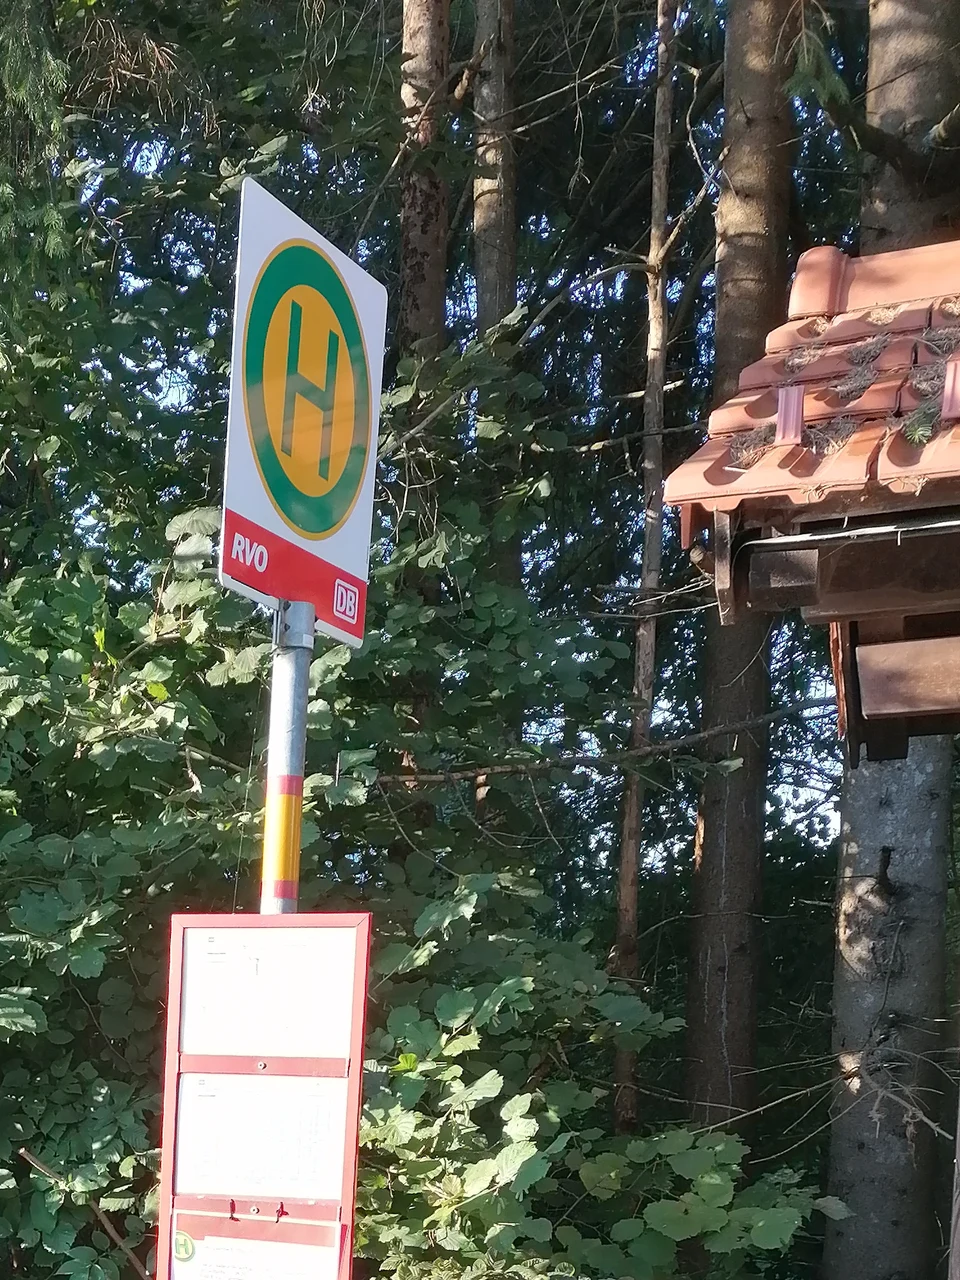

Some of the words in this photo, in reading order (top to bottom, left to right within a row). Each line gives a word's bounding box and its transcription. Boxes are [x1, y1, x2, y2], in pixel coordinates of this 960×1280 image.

[281, 299, 339, 483] H
[232, 532, 268, 573] RVO
[337, 585, 357, 618] DB
